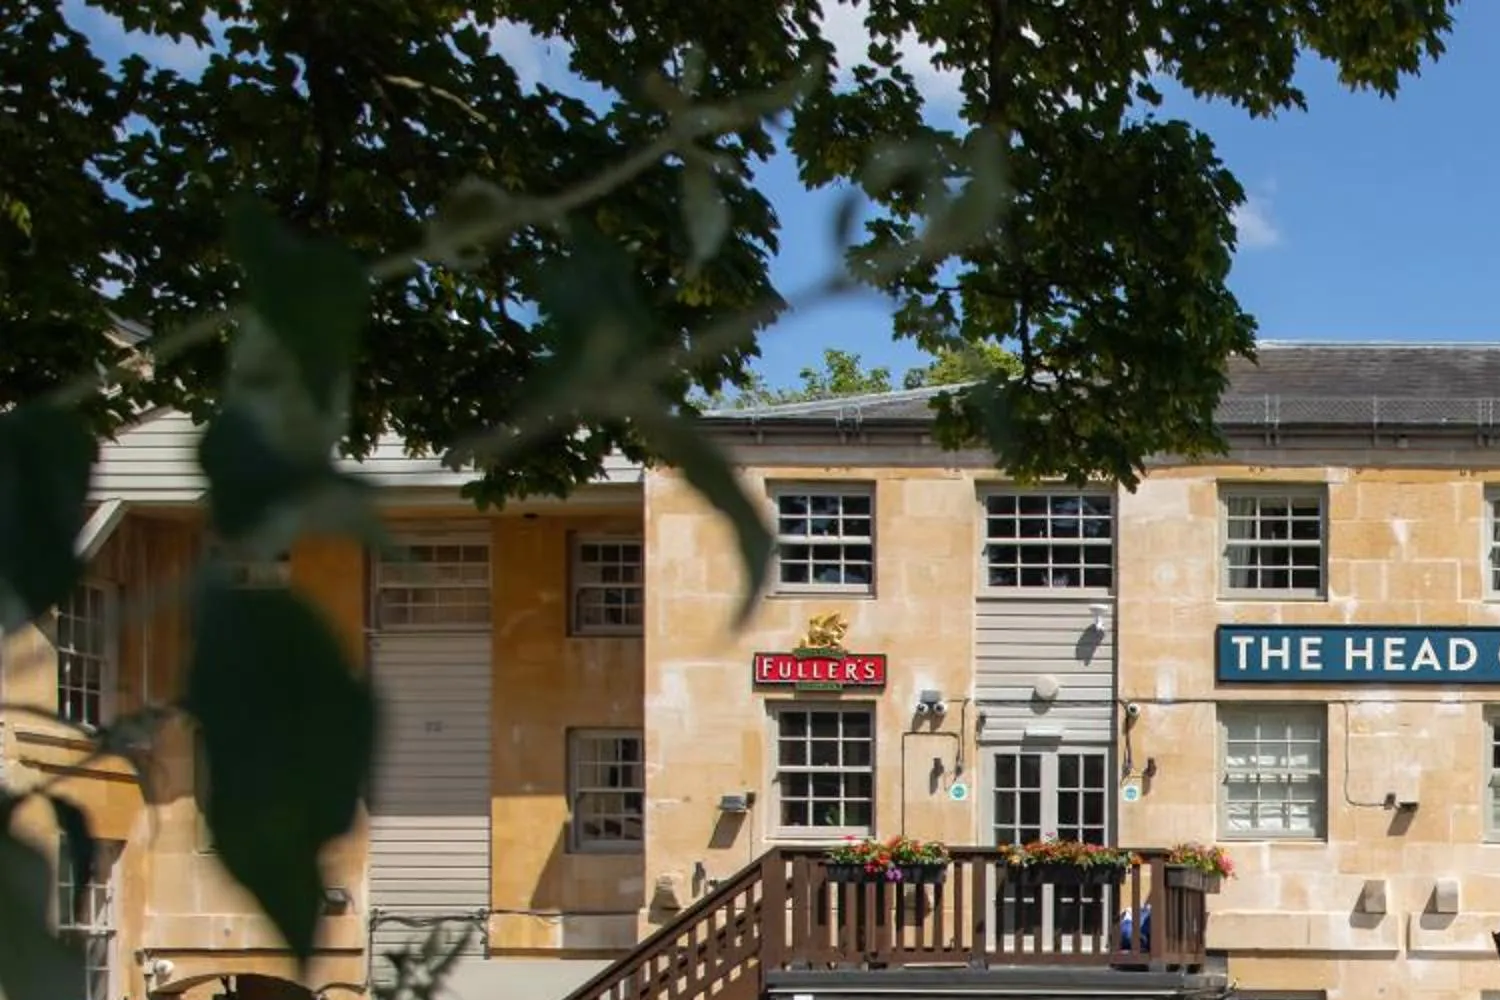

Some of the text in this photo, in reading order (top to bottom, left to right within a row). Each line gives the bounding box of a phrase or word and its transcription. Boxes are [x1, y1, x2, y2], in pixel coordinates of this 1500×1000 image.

[762, 657, 876, 680] FULLER'S
[1231, 635, 1323, 671] THE
[1344, 636, 1478, 672] HEAD
